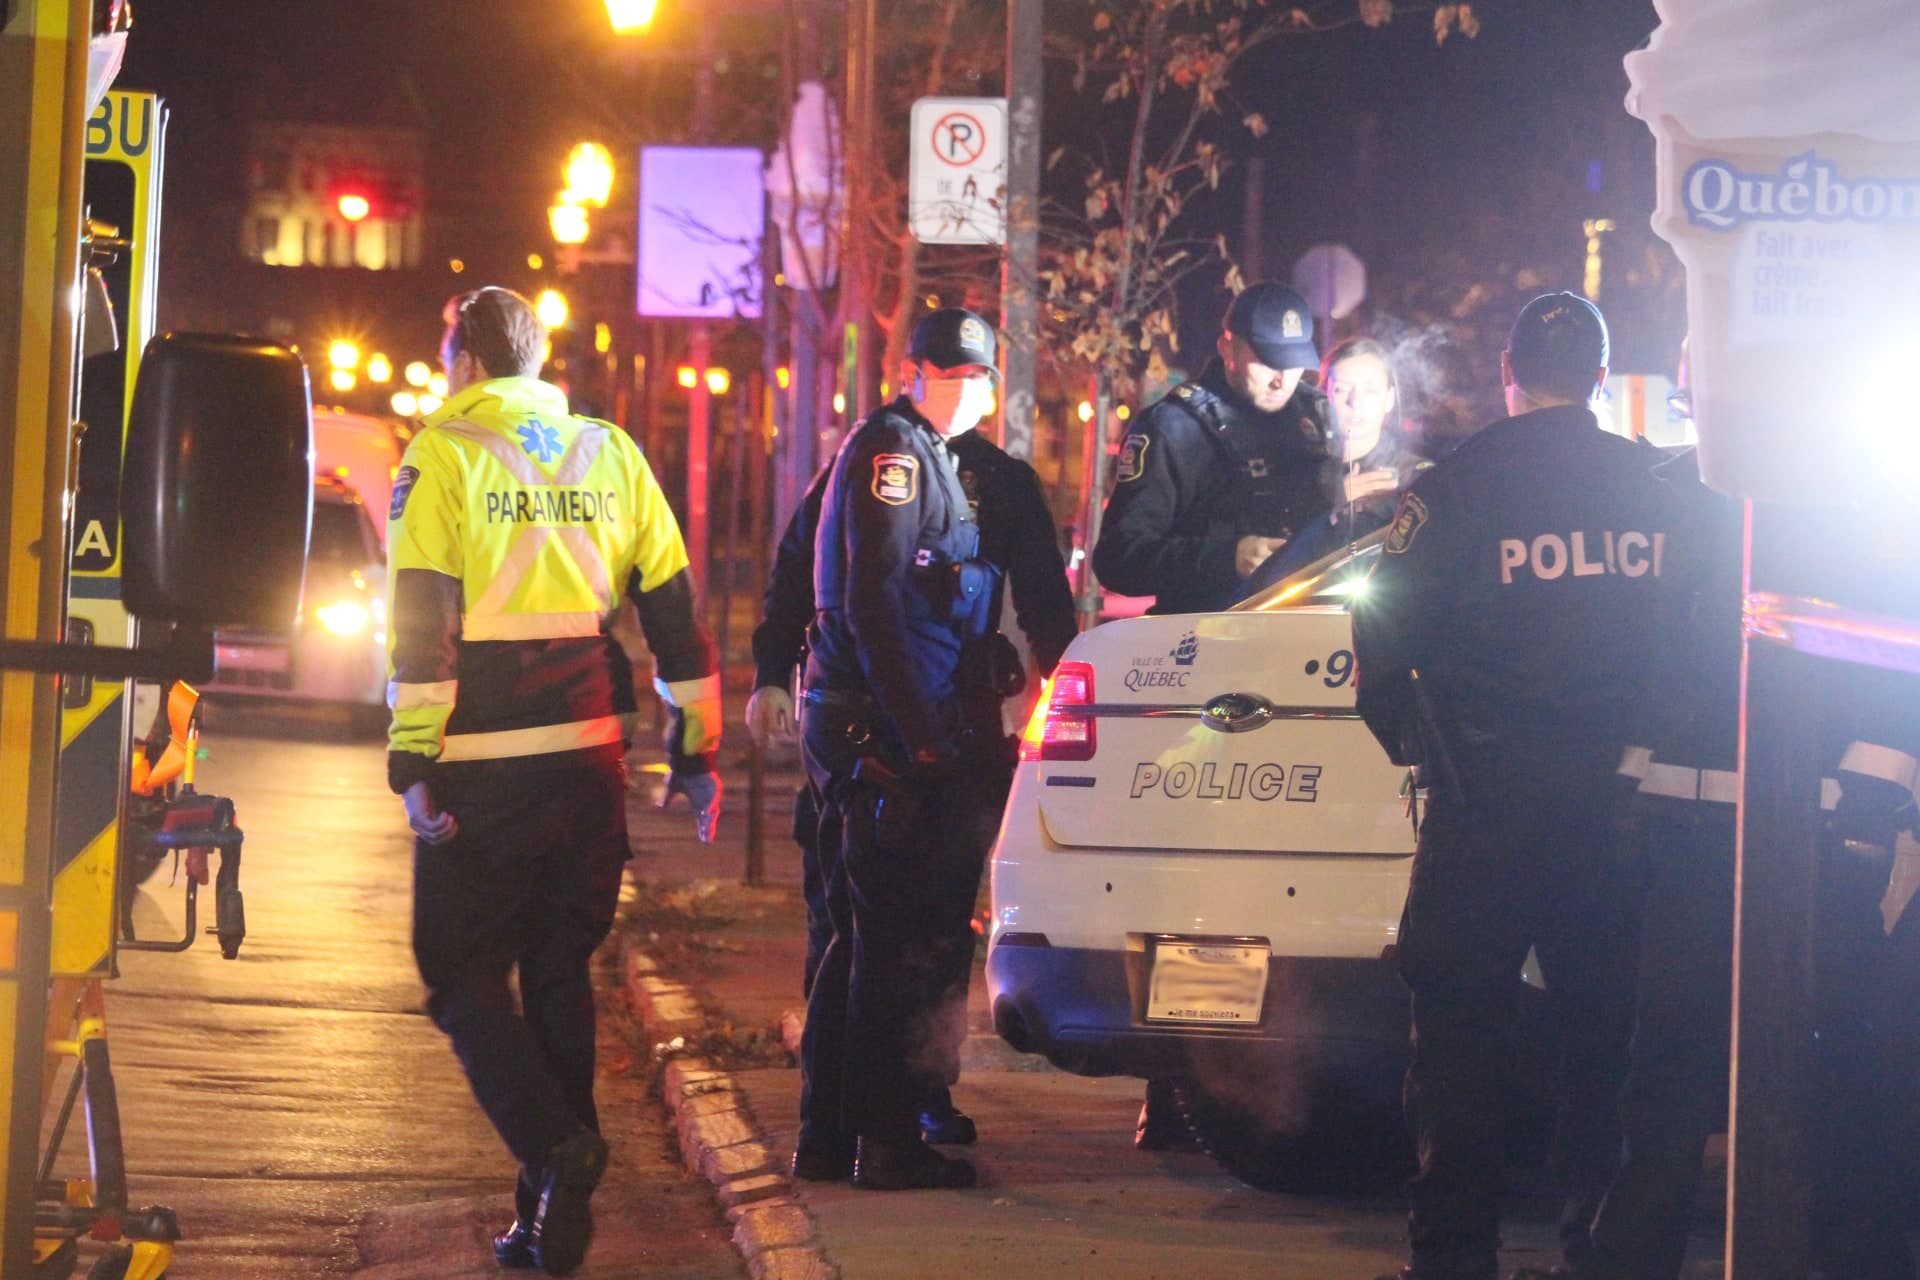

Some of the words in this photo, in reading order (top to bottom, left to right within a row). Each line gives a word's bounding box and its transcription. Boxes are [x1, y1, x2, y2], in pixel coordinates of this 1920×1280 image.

[950, 123, 972, 158] P
[1689, 160, 1919, 226] Québon
[485, 490, 616, 524] PARAMEDIC
[75, 519, 112, 557] A
[1323, 649, 1356, 688] 9
[1130, 761, 1322, 802] POLICE
